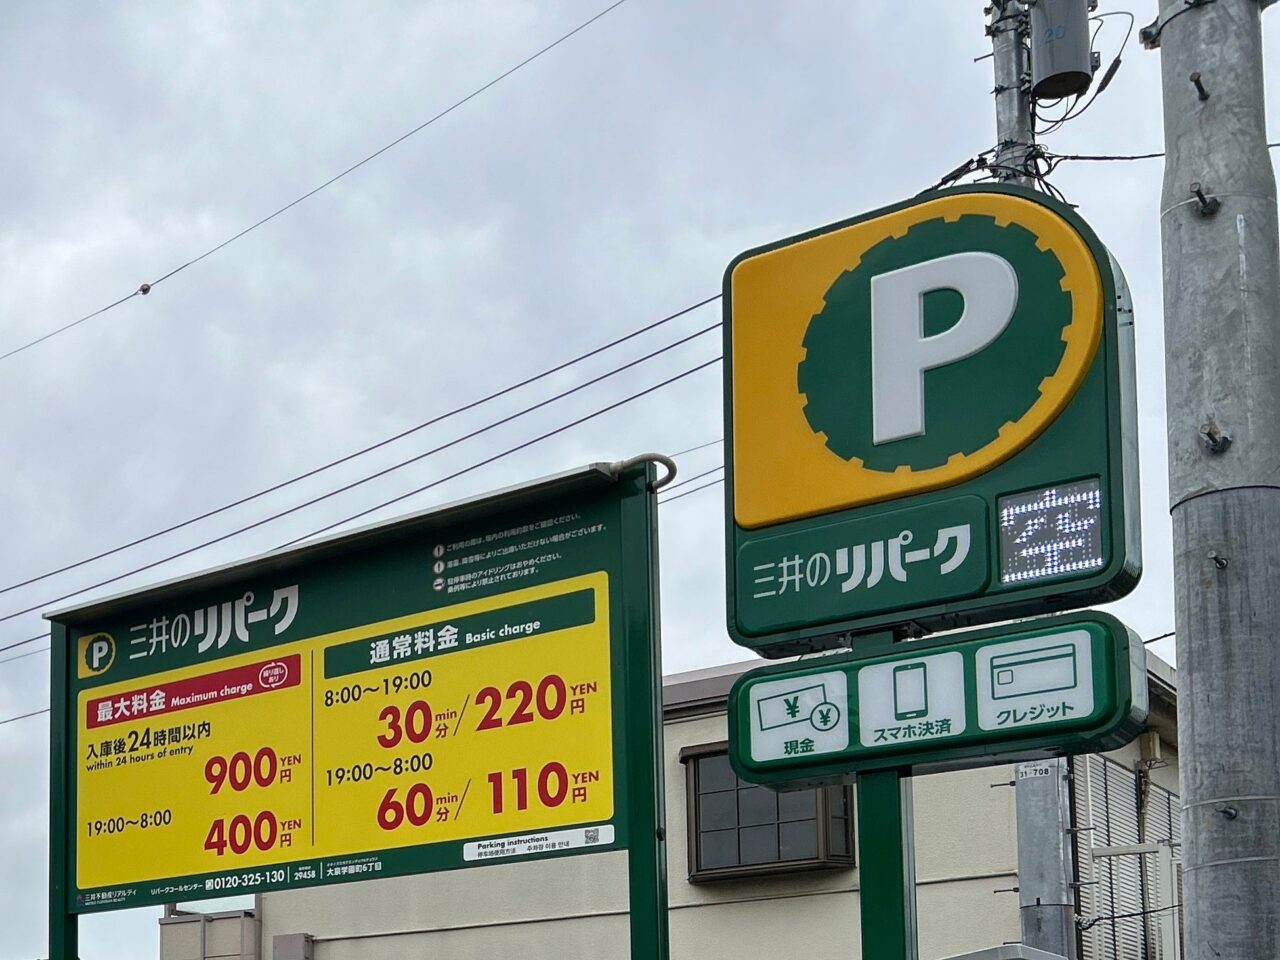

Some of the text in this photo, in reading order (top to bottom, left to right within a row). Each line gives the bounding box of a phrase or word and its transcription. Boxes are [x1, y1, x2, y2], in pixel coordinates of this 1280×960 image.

[871, 251, 1019, 446] P
[1000, 488, 1103, 584] 空
[753, 524, 971, 599] 三井のリパーク
[129, 584, 299, 660] 三井のリパーク
[466, 620, 541, 645] Basic charge
[92, 641, 109, 668] P
[370, 624, 459, 665] 通常料金
[96, 689, 166, 723] 最大料金
[171, 682, 253, 707] Maximum charge
[570, 698, 585, 715] 円
[377, 700, 433, 749] 30
[435, 709, 458, 721] min
[475, 674, 568, 732] 220
[570, 681, 598, 696] YEN
[997, 702, 1074, 726] クレジット
[86, 721, 211, 761] 入庫後24時間以内
[435, 723, 449, 739] 分
[874, 718, 952, 743] スマホ決済
[86, 745, 194, 772] within 24 hours of entry
[784, 738, 815, 755] 現金
[204, 747, 302, 796] 900 YEN
[280, 768, 292, 783] 円
[377, 783, 434, 831] 60
[436, 792, 459, 805] min
[487, 762, 569, 814] 110
[572, 770, 600, 785] YEN
[572, 787, 587, 804] 円
[436, 807, 450, 822] 分
[204, 811, 302, 857] 400 YEN
[280, 833, 292, 848] 円
[477, 835, 549, 850] Parking instructions
[214, 869, 285, 889] 0120-325-130
[294, 870, 316, 881] 29458
